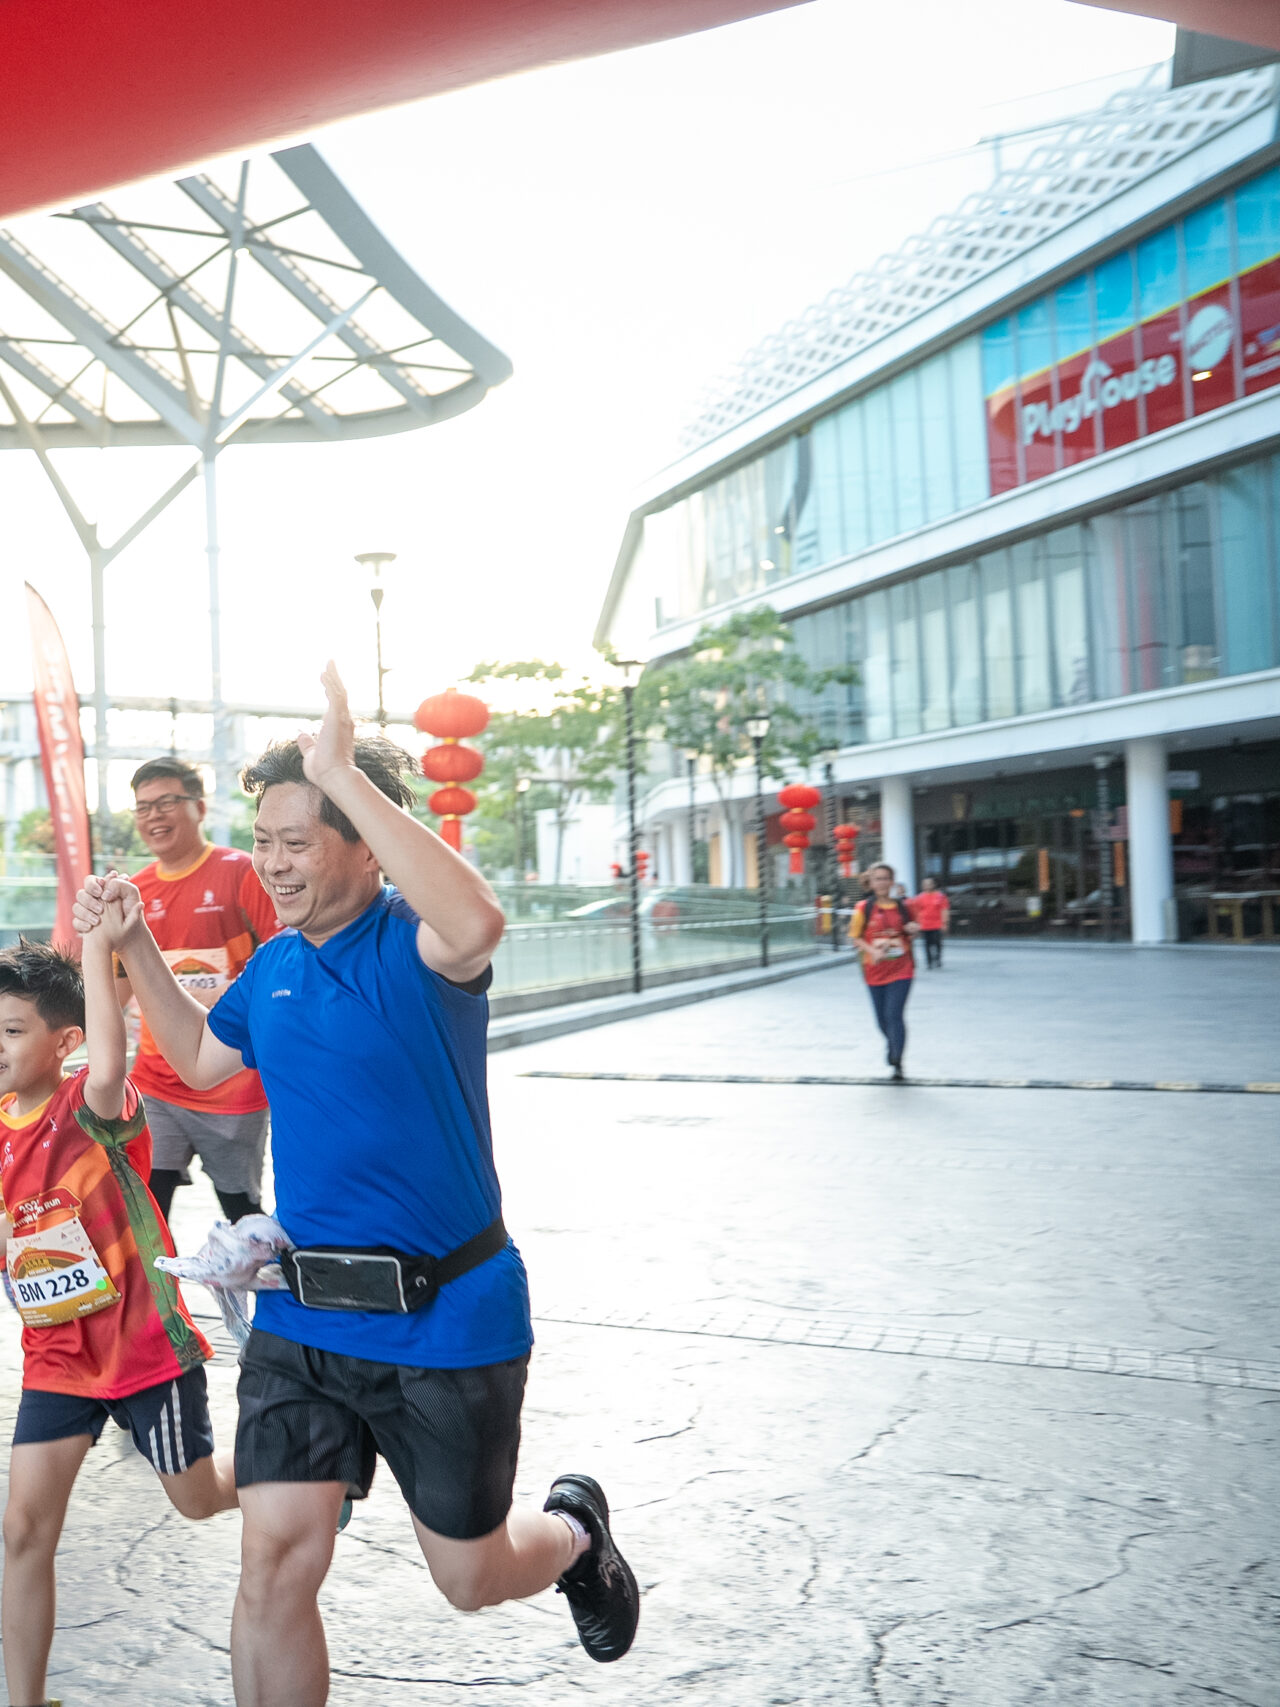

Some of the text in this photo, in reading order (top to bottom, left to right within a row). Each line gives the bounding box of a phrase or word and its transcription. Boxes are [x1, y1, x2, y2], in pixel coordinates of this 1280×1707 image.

[19, 1199, 40, 1214] 202
[18, 1282, 46, 1303] BM
[45, 1269, 90, 1298] 228
